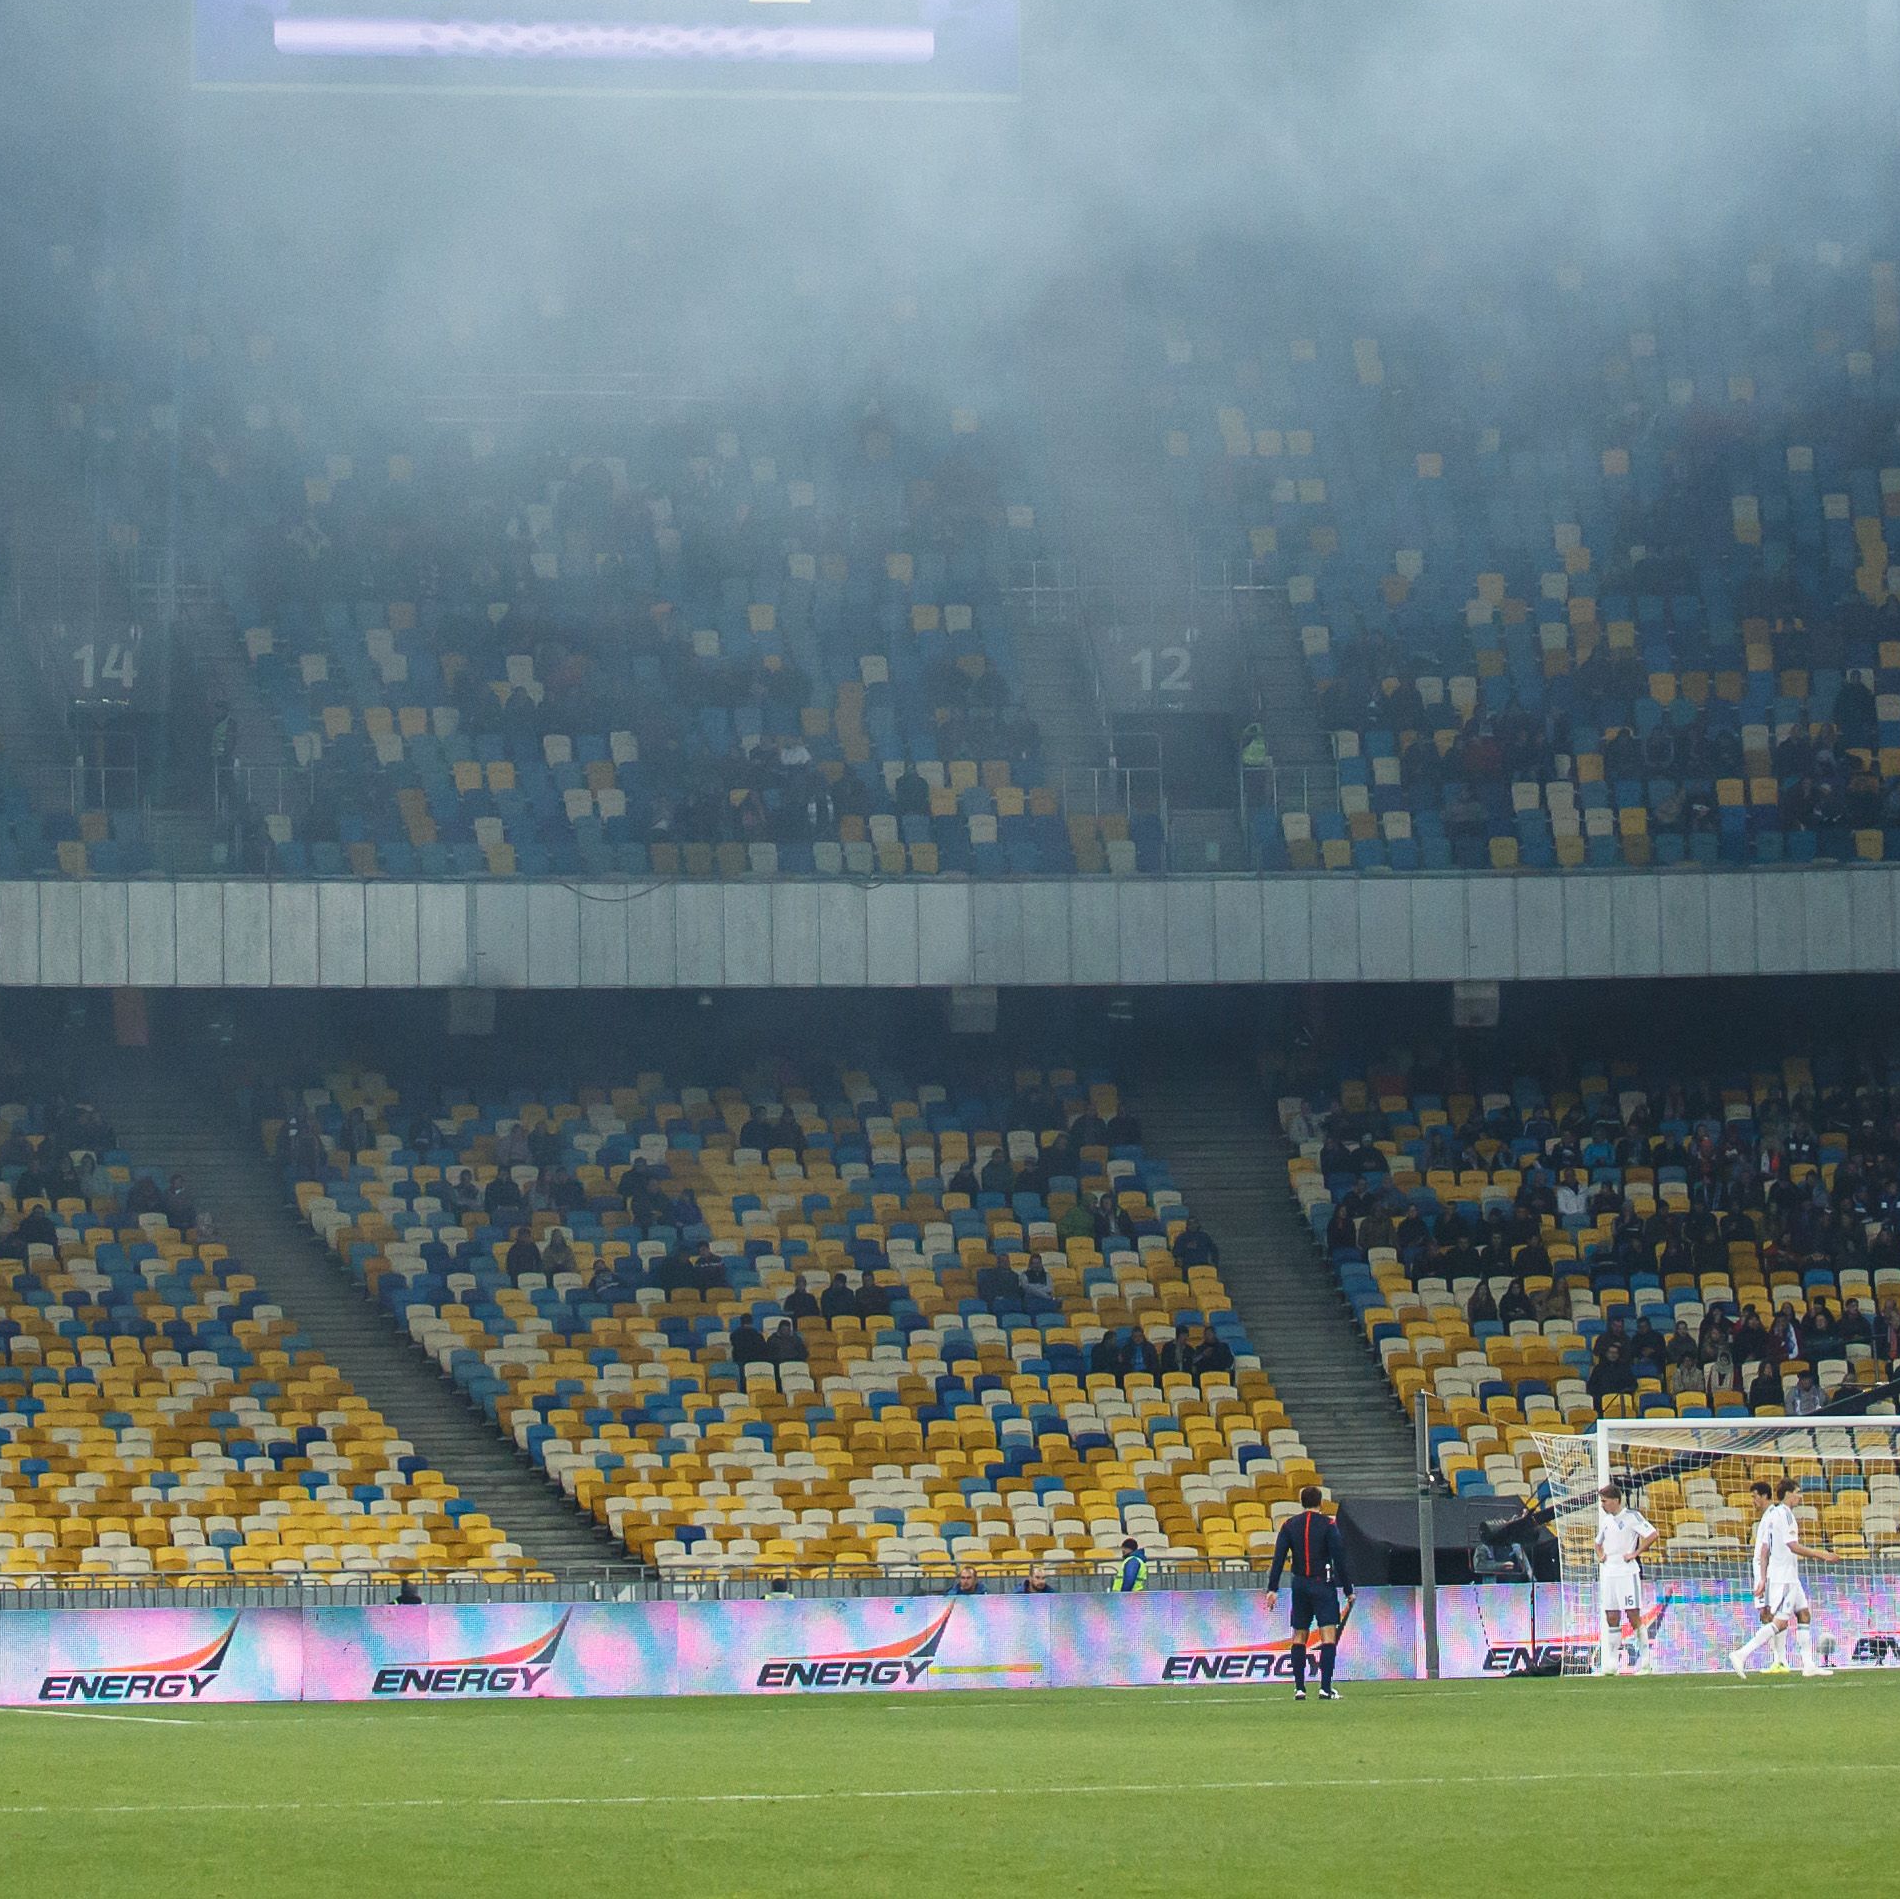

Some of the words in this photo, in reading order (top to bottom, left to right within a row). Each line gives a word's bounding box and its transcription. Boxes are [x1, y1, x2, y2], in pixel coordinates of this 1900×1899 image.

[73, 642, 138, 689] 14
[1131, 646, 1193, 691] 12
[39, 1673, 216, 1700] ENERGY
[372, 1666, 552, 1694] ENERGY
[756, 1659, 933, 1687] ENERGY
